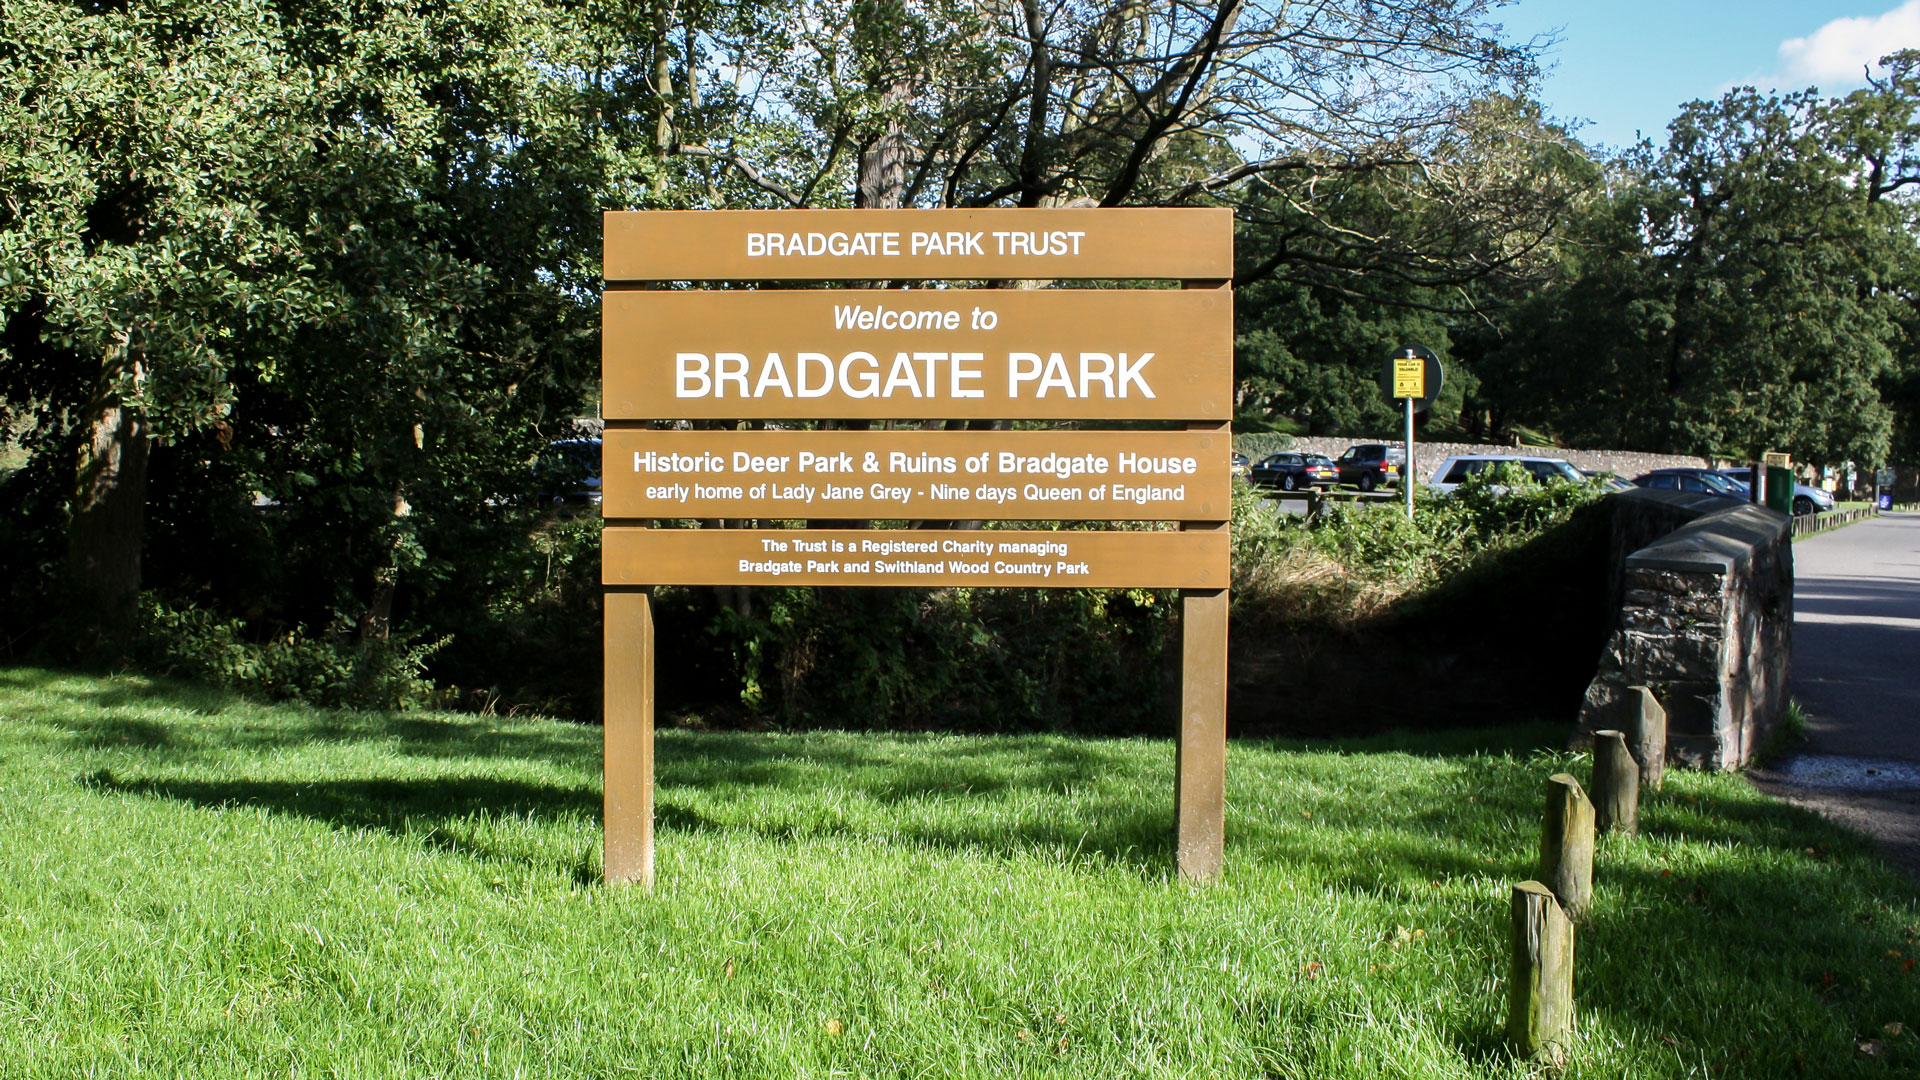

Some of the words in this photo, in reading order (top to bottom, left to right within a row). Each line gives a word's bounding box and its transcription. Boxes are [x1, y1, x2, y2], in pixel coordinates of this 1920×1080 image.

[746, 231, 901, 258] BRADGATE
[911, 231, 985, 257] PARK
[991, 230, 1087, 257] TRUST
[833, 304, 961, 331] Welcome
[970, 306, 999, 331] to
[675, 350, 985, 399] BRADGATE
[1007, 351, 1157, 399] PARK
[633, 451, 725, 473] Historic
[732, 451, 791, 473] Deer
[798, 451, 855, 473] Park
[861, 451, 881, 474] &
[889, 451, 958, 474] Ruins
[964, 451, 990, 474] of
[998, 451, 1110, 480] Bradgate
[1118, 451, 1198, 475] House
[645, 482, 690, 504] early
[694, 482, 744, 500] home
[748, 482, 767, 500] of
[771, 482, 816, 504] Lady
[820, 483, 865, 500] Jane
[869, 482, 913, 505] Grey
[930, 483, 971, 501] Nine
[975, 483, 1018, 505] days
[1023, 483, 1083, 501] Queen
[1087, 483, 1107, 501] of
[1111, 483, 1185, 505] England
[761, 538, 789, 553] The
[791, 539, 828, 553] Trust
[831, 539, 845, 553] is
[847, 542, 858, 553] a
[861, 539, 939, 556] Registered
[942, 539, 995, 557] Charity
[998, 540, 1068, 557] managing
[738, 559, 803, 576] Bradgate
[806, 559, 840, 573] Park
[843, 560, 871, 574] and
[874, 559, 945, 574] Swithland
[948, 560, 990, 574] Wood
[993, 560, 1052, 578] Country
[1056, 561, 1090, 575] Park
